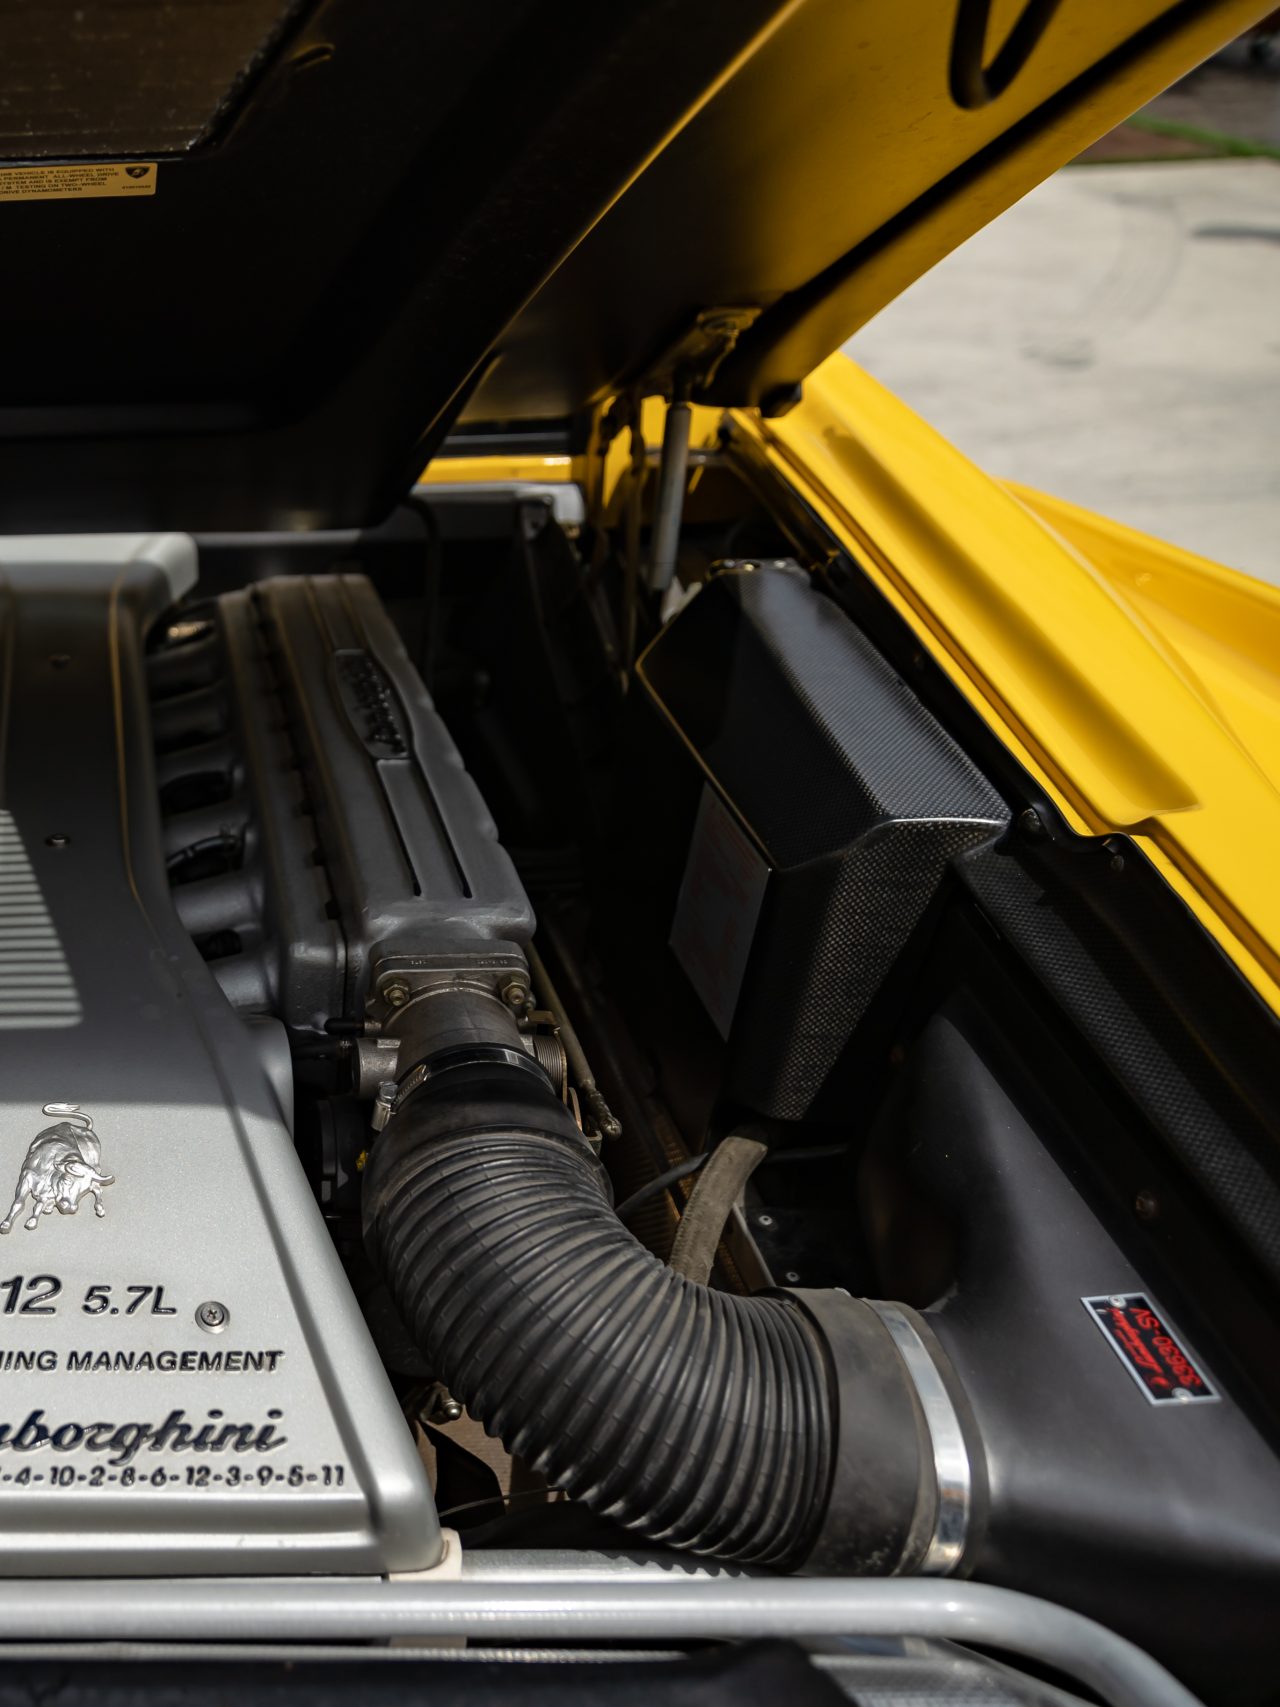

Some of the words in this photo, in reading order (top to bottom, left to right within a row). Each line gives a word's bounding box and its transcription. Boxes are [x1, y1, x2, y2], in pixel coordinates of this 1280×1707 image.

[82, 1285, 177, 1315] 5.7L
[67, 1350, 285, 1372] MANAGEMENT
[1129, 1307, 1202, 1387] 33630-SV
